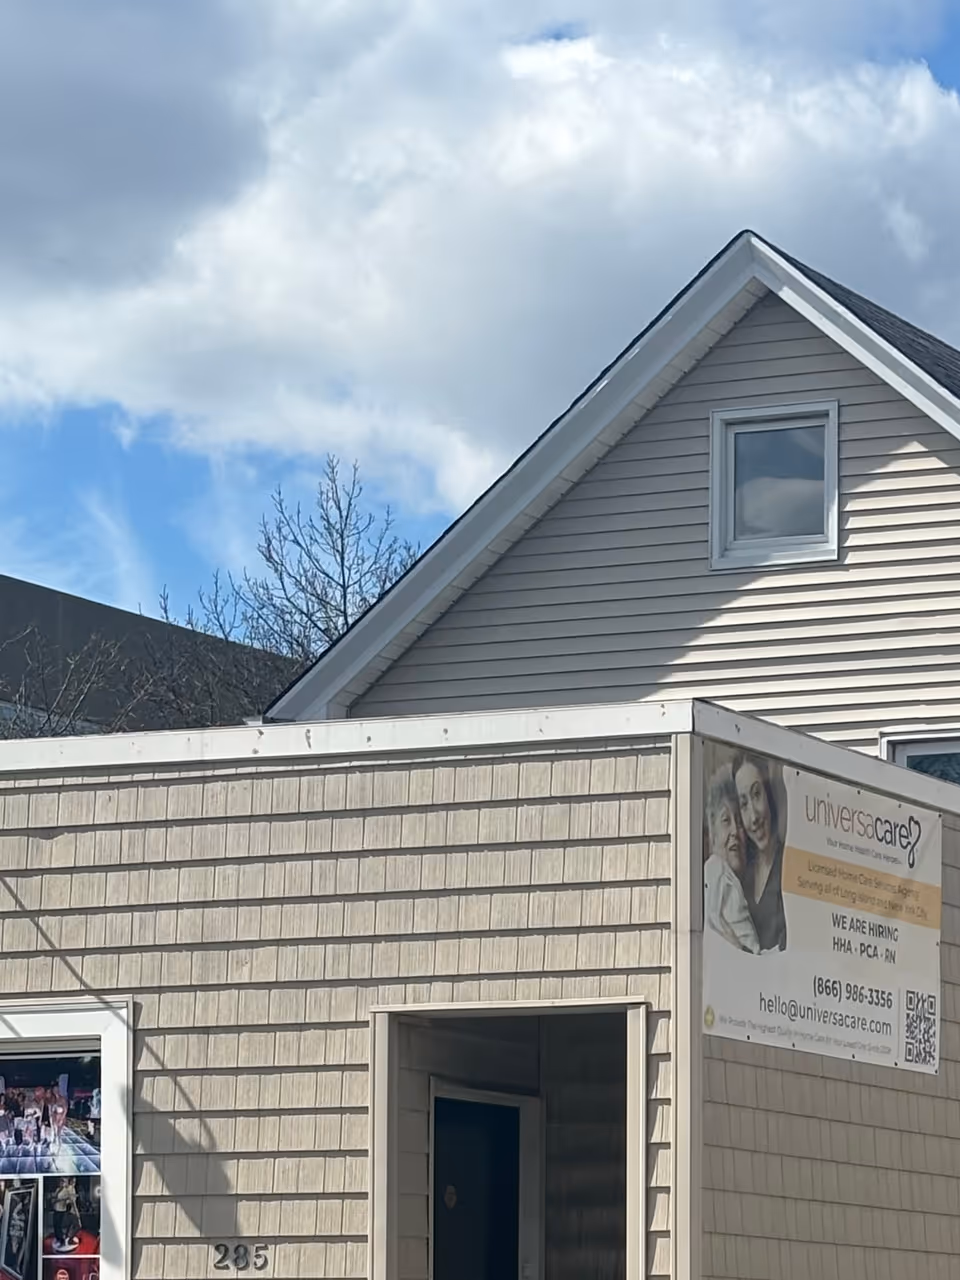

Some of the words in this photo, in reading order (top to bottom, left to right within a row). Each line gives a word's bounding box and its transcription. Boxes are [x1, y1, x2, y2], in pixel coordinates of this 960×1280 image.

[805, 792, 910, 850] universacare
[797, 875, 824, 896] Serving
[840, 887, 857, 904] Long
[831, 912, 847, 930] WE
[848, 917, 867, 935] ARE
[868, 921, 899, 942] HIRING
[832, 936, 853, 954] HHA
[860, 942, 879, 960] PCA
[884, 948, 896, 964] RN
[813, 975, 842, 1003] (866)
[845, 982, 893, 1009] 986-3356
[759, 992, 892, 1036] hello@universacare.com
[213, 1243, 269, 1271] 285
